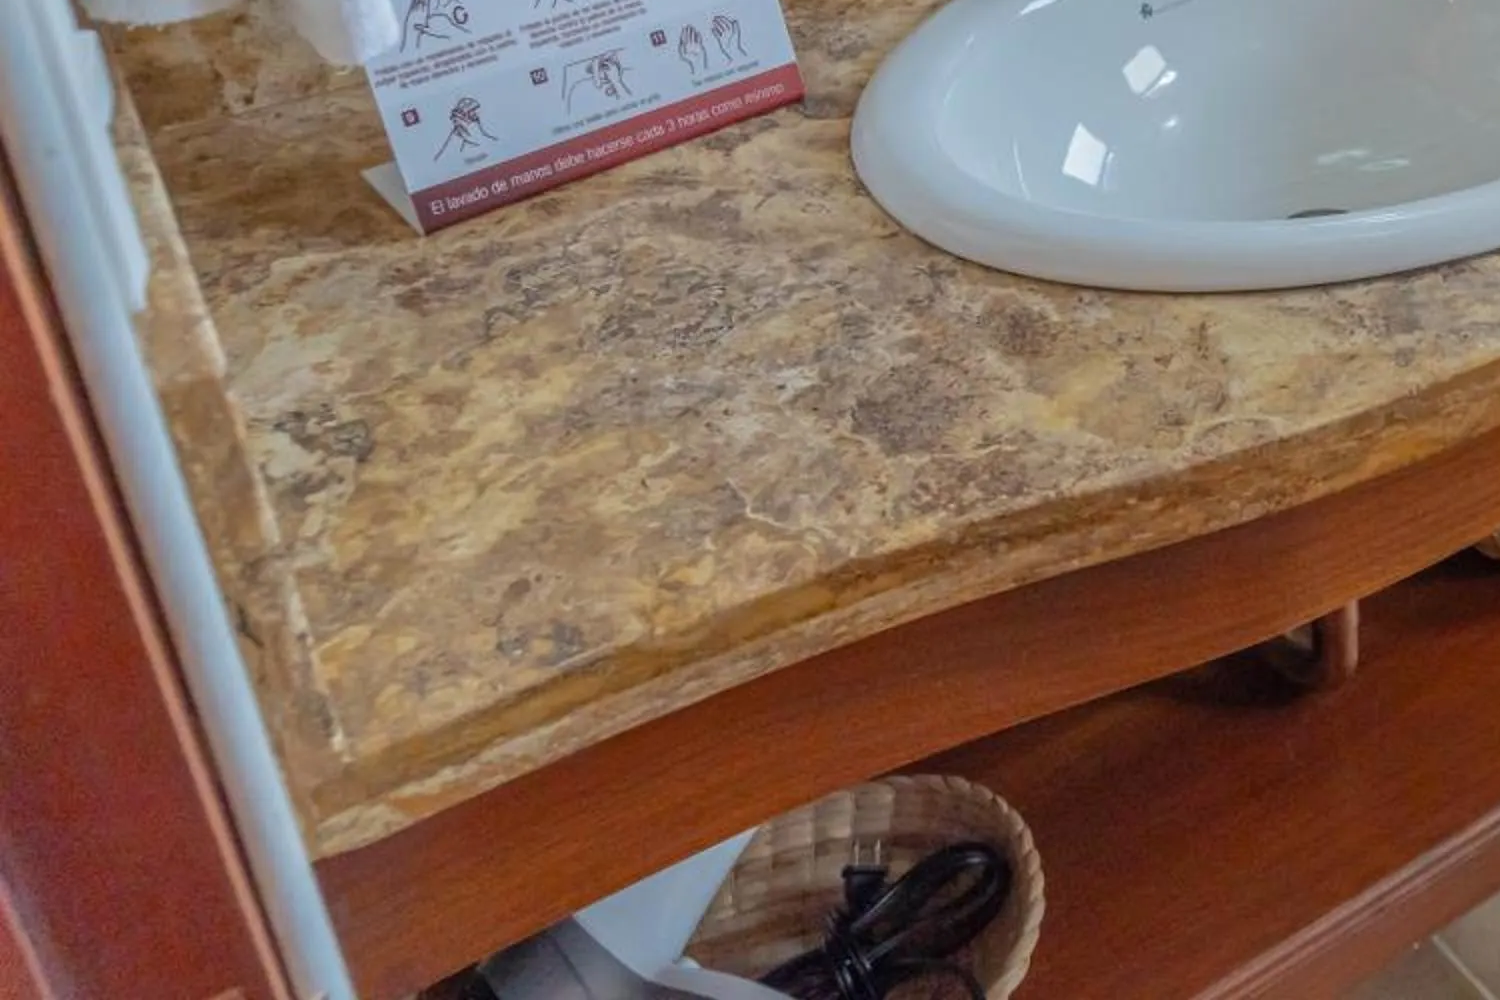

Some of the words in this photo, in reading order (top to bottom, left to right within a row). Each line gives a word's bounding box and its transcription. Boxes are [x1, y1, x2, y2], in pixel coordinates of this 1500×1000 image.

[431, 199, 444, 216] El
[445, 186, 489, 210] lavado
[491, 179, 509, 195] de
[510, 165, 553, 187] manos
[554, 152, 585, 173] debe
[586, 135, 634, 161] hacerse
[636, 125, 665, 144] cada
[665, 118, 676, 132] 3
[677, 108, 711, 130] horas
[711, 98, 743, 117] como
